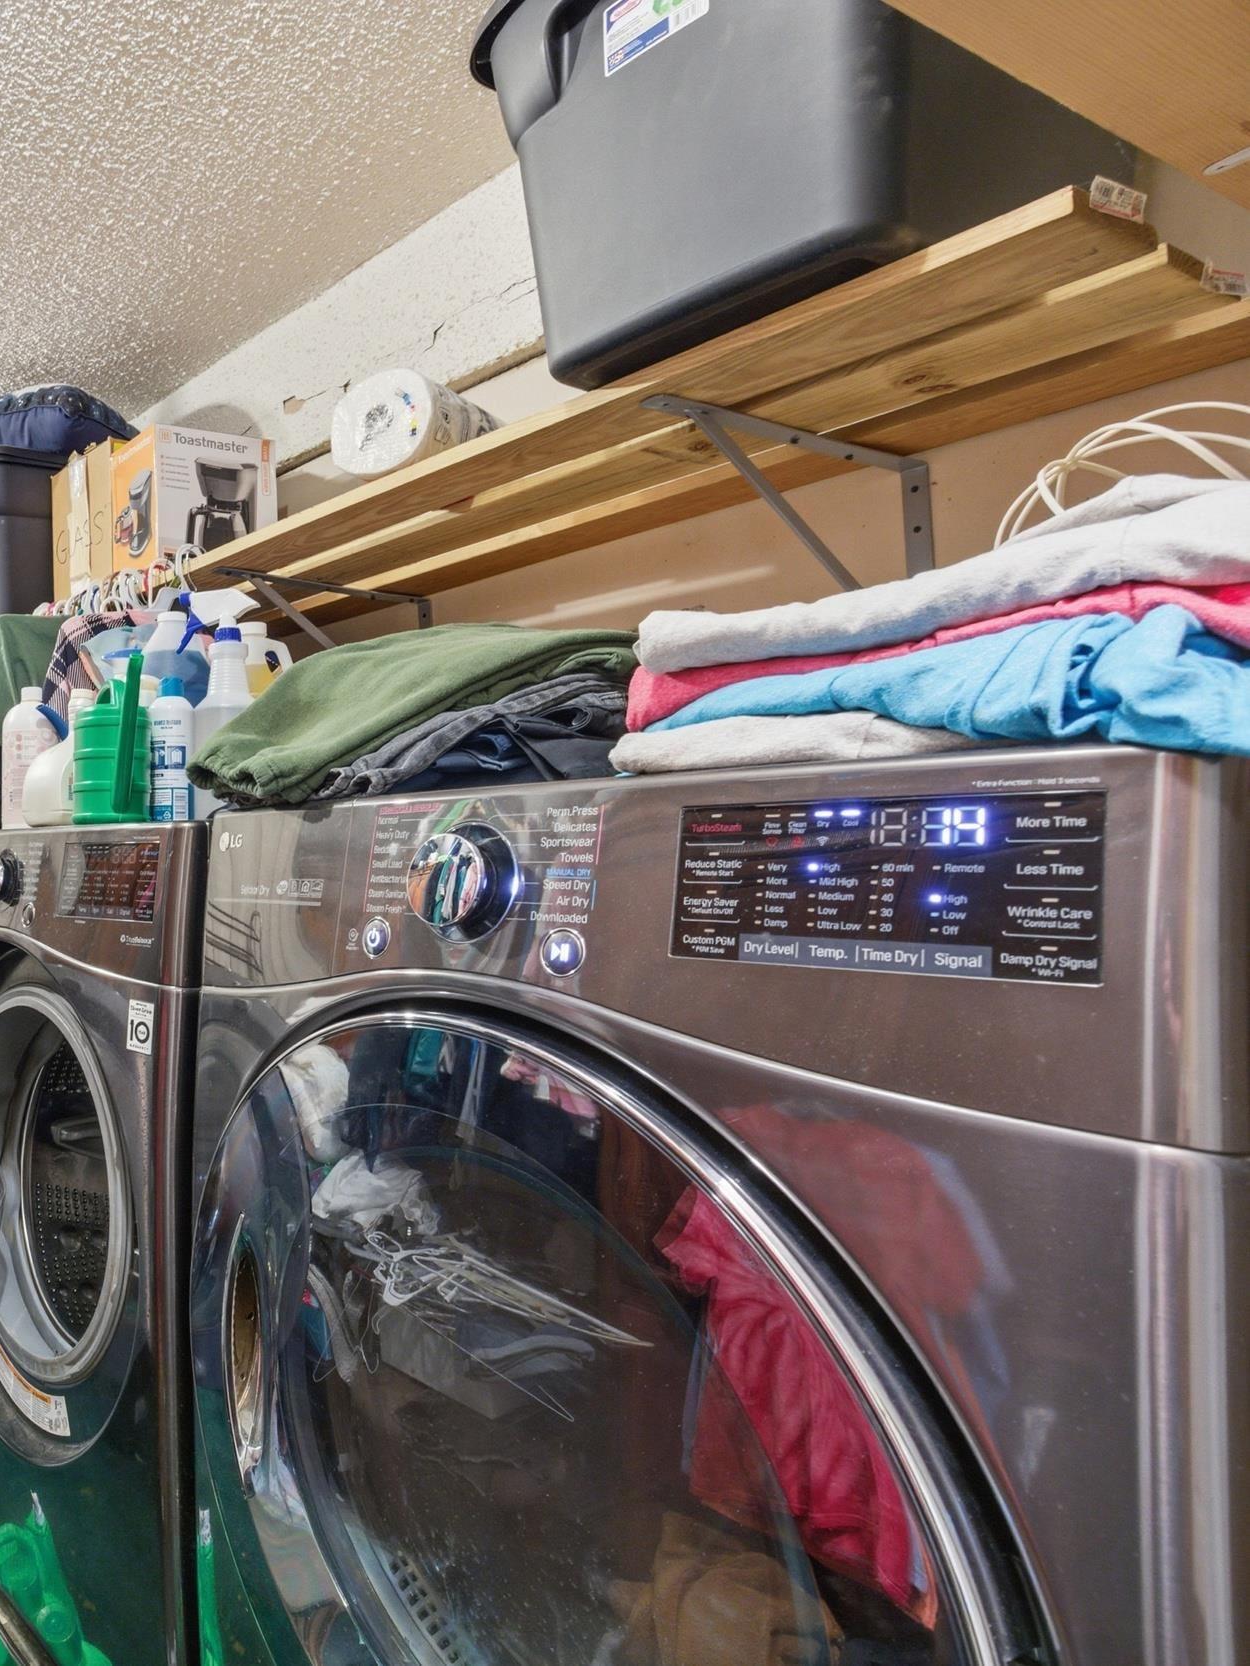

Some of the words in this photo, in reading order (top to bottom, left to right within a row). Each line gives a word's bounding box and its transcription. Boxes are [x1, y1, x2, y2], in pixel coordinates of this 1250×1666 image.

[173, 432, 248, 454] Toastmaster
[998, 778, 1032, 787] Function
[1016, 816, 1050, 828] More
[1053, 816, 1087, 827] Time
[553, 822, 597, 833] Delicates
[692, 823, 742, 833] TurboSteam
[230, 834, 243, 848] LG
[540, 837, 595, 848] Sportswear
[560, 852, 594, 863] Towels
[685, 859, 716, 869] Reduce
[718, 859, 743, 869] Static
[767, 862, 788, 872] Very
[821, 863, 841, 873] High
[896, 863, 914, 872] min
[944, 863, 986, 873] Remote
[1016, 863, 1047, 875] Less
[1050, 863, 1085, 875] Time
[576, 868, 591, 877] DRY
[542, 879, 572, 891] Speed
[573, 880, 591, 893] Dry
[766, 877, 788, 886] More
[819, 876, 837, 886] Mid
[838, 877, 858, 888] High
[881, 877, 894, 887] 50
[765, 890, 796, 899] Normal
[818, 891, 854, 901] Medium
[881, 892, 894, 902] 40
[944, 894, 968, 905] High
[556, 895, 570, 906] Air
[572, 896, 590, 909] Dry
[683, 897, 712, 908] Energy
[713, 898, 739, 907] Saver
[764, 904, 784, 913] Less
[818, 906, 838, 915] Low
[880, 907, 893, 917] 30
[1007, 905, 1057, 918] Wrinkle
[1060, 907, 1093, 919] Care
[530, 911, 588, 924] Downloaded
[943, 911, 966, 920] Low
[763, 918, 788, 928] Damp
[817, 921, 839, 930] Ultra
[841, 922, 861, 931] Low
[880, 923, 892, 932] 20
[1023, 919, 1056, 929] Control
[1057, 920, 1080, 929] Lock
[942, 925, 958, 935] Off
[682, 934, 714, 944] Custom
[715, 935, 736, 946] PGM
[743, 941, 764, 956] Dry
[765, 942, 795, 955] Level
[809, 945, 848, 959] Temp.
[861, 948, 892, 962] Time
[894, 949, 919, 966] Dry
[934, 953, 983, 969] Signal
[1000, 953, 1033, 967] Damp
[1035, 955, 1057, 969] Dry
[1058, 957, 1098, 971] Signal
[1037, 968, 1064, 977] Wi-Fi
[130, 1019, 150, 1044] 10
